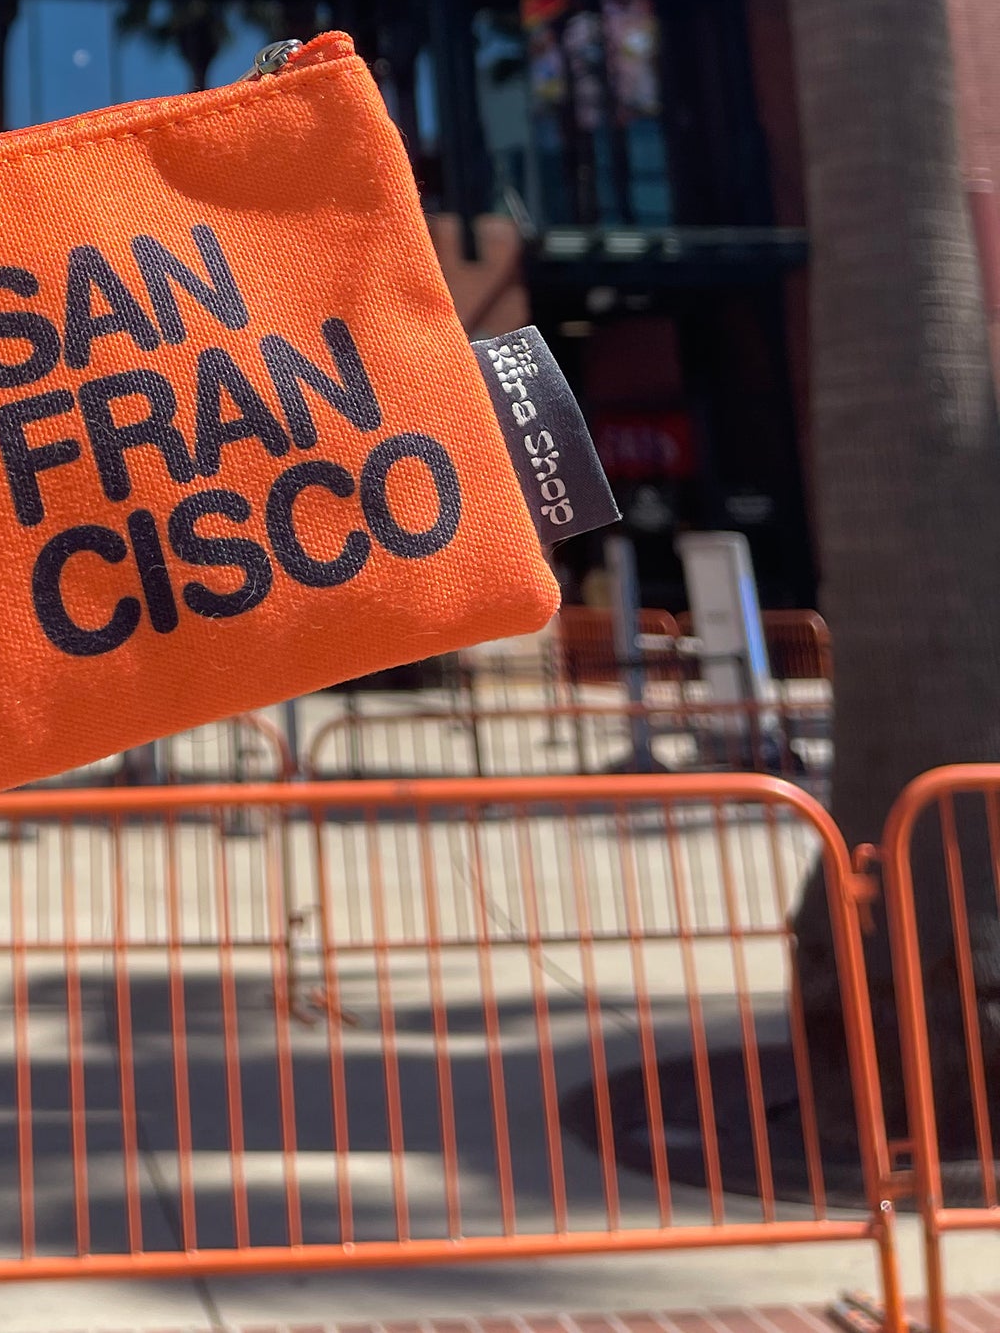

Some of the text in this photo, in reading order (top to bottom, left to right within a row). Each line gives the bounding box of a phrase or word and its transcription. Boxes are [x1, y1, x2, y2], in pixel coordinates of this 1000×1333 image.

[487, 344, 574, 526] Kira Shop
[512, 337, 540, 378] The
[30, 432, 463, 657] CISCO
